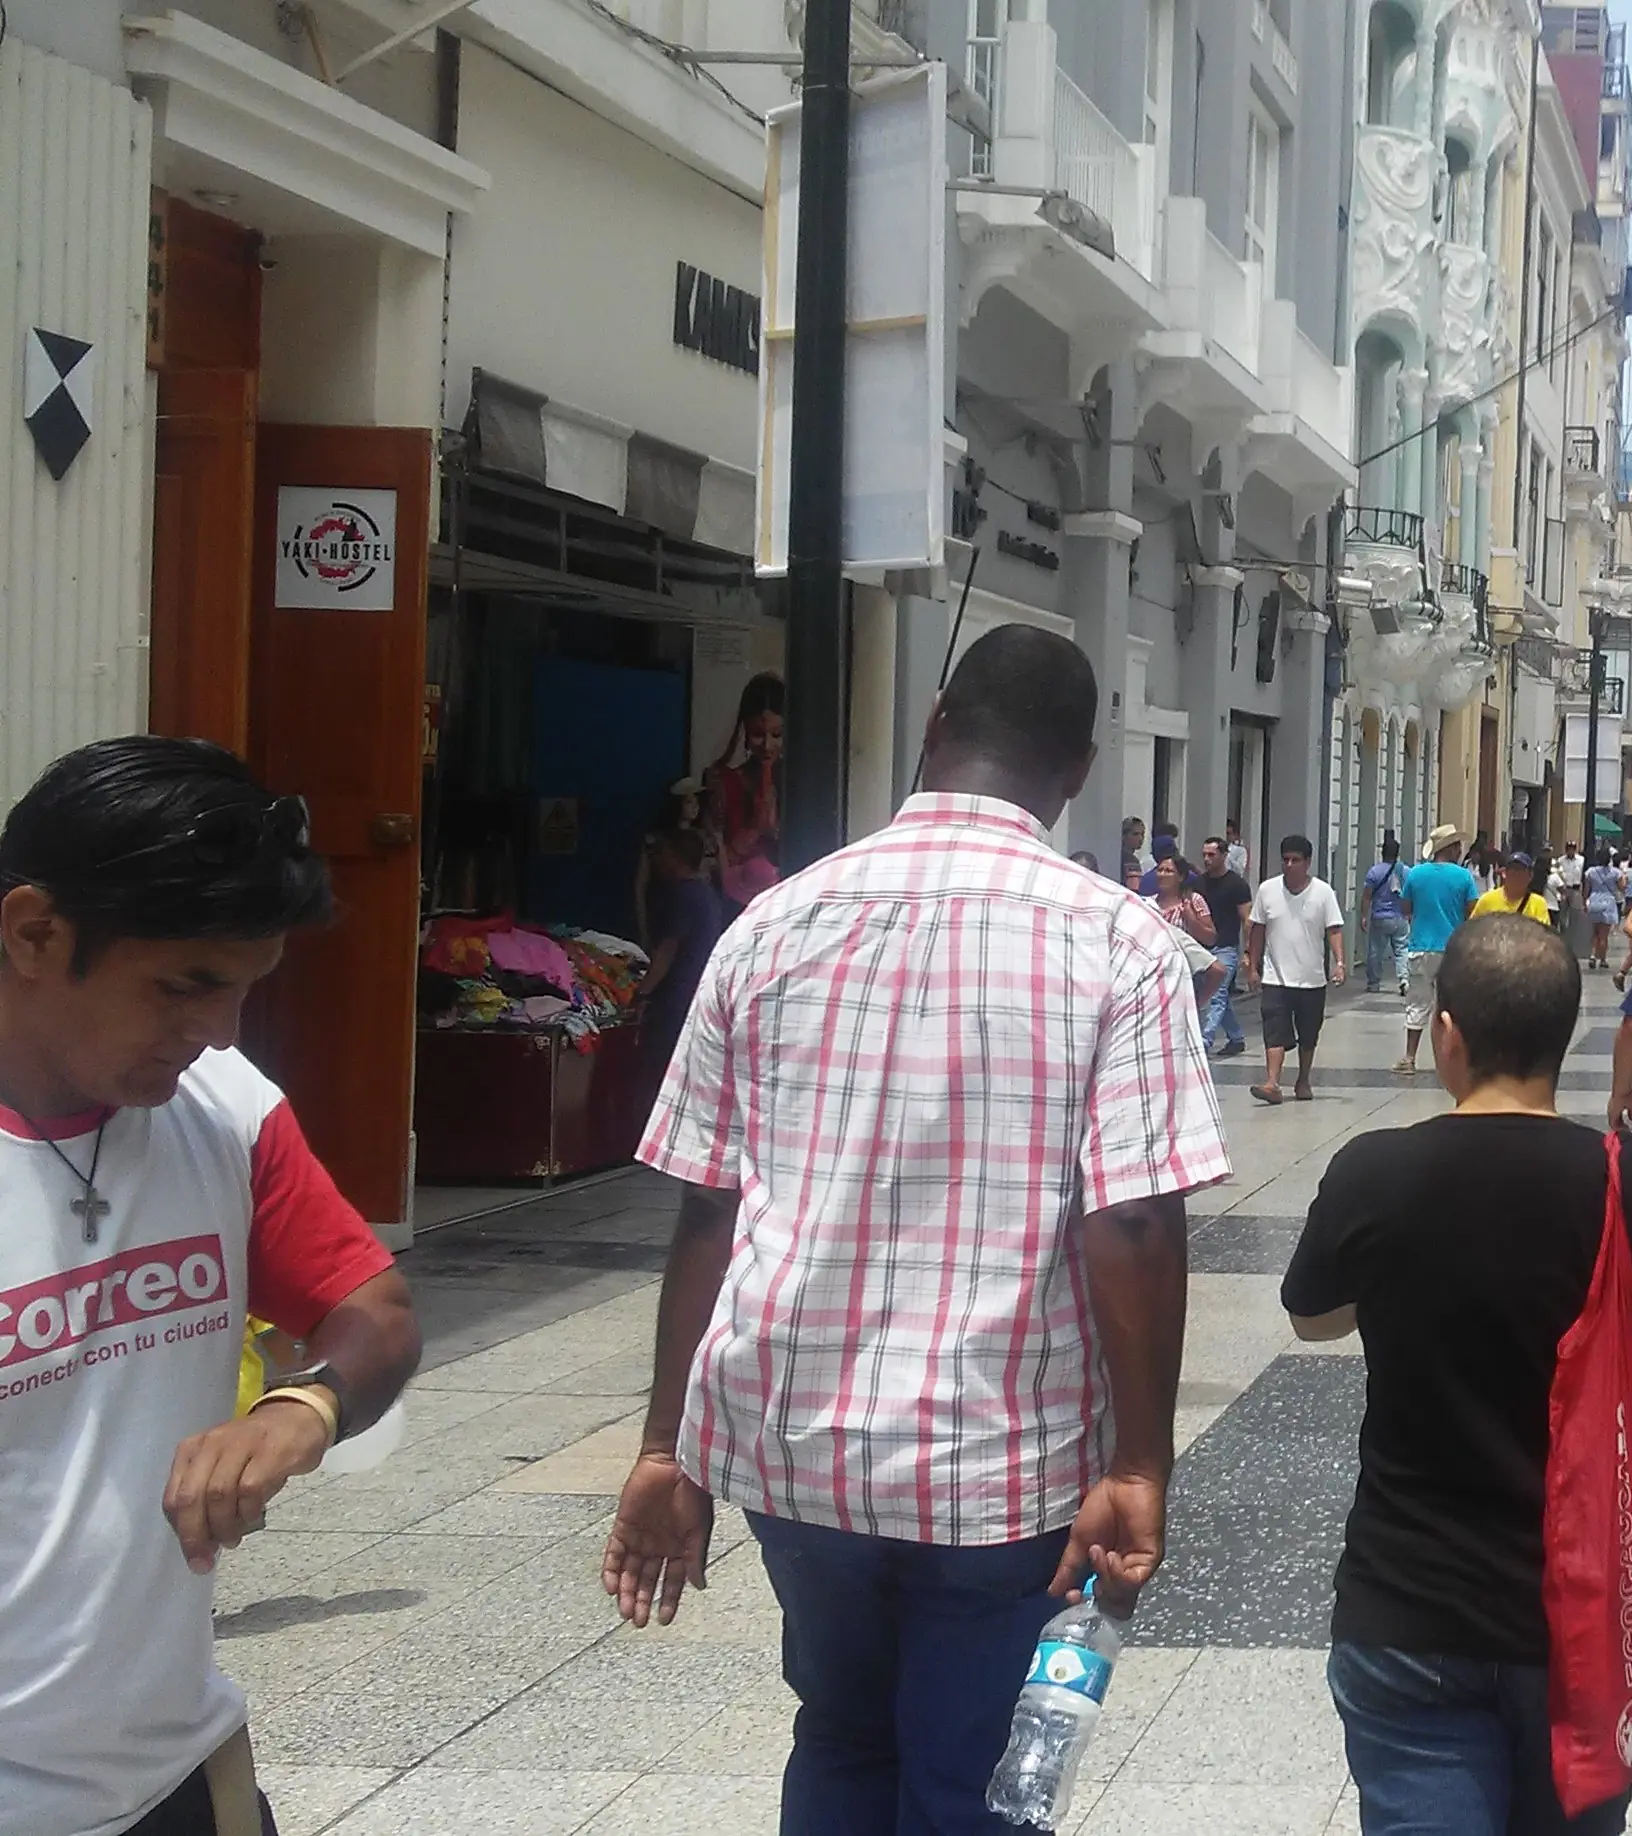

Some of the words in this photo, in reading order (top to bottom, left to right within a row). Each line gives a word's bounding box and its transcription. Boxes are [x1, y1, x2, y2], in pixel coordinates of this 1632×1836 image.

[282, 541, 319, 559] YAKI
[330, 543, 391, 560] HOSTEL
[84, 1341, 128, 1367] con
[135, 1333, 156, 1352] tu
[163, 1311, 229, 1344] ciudad
